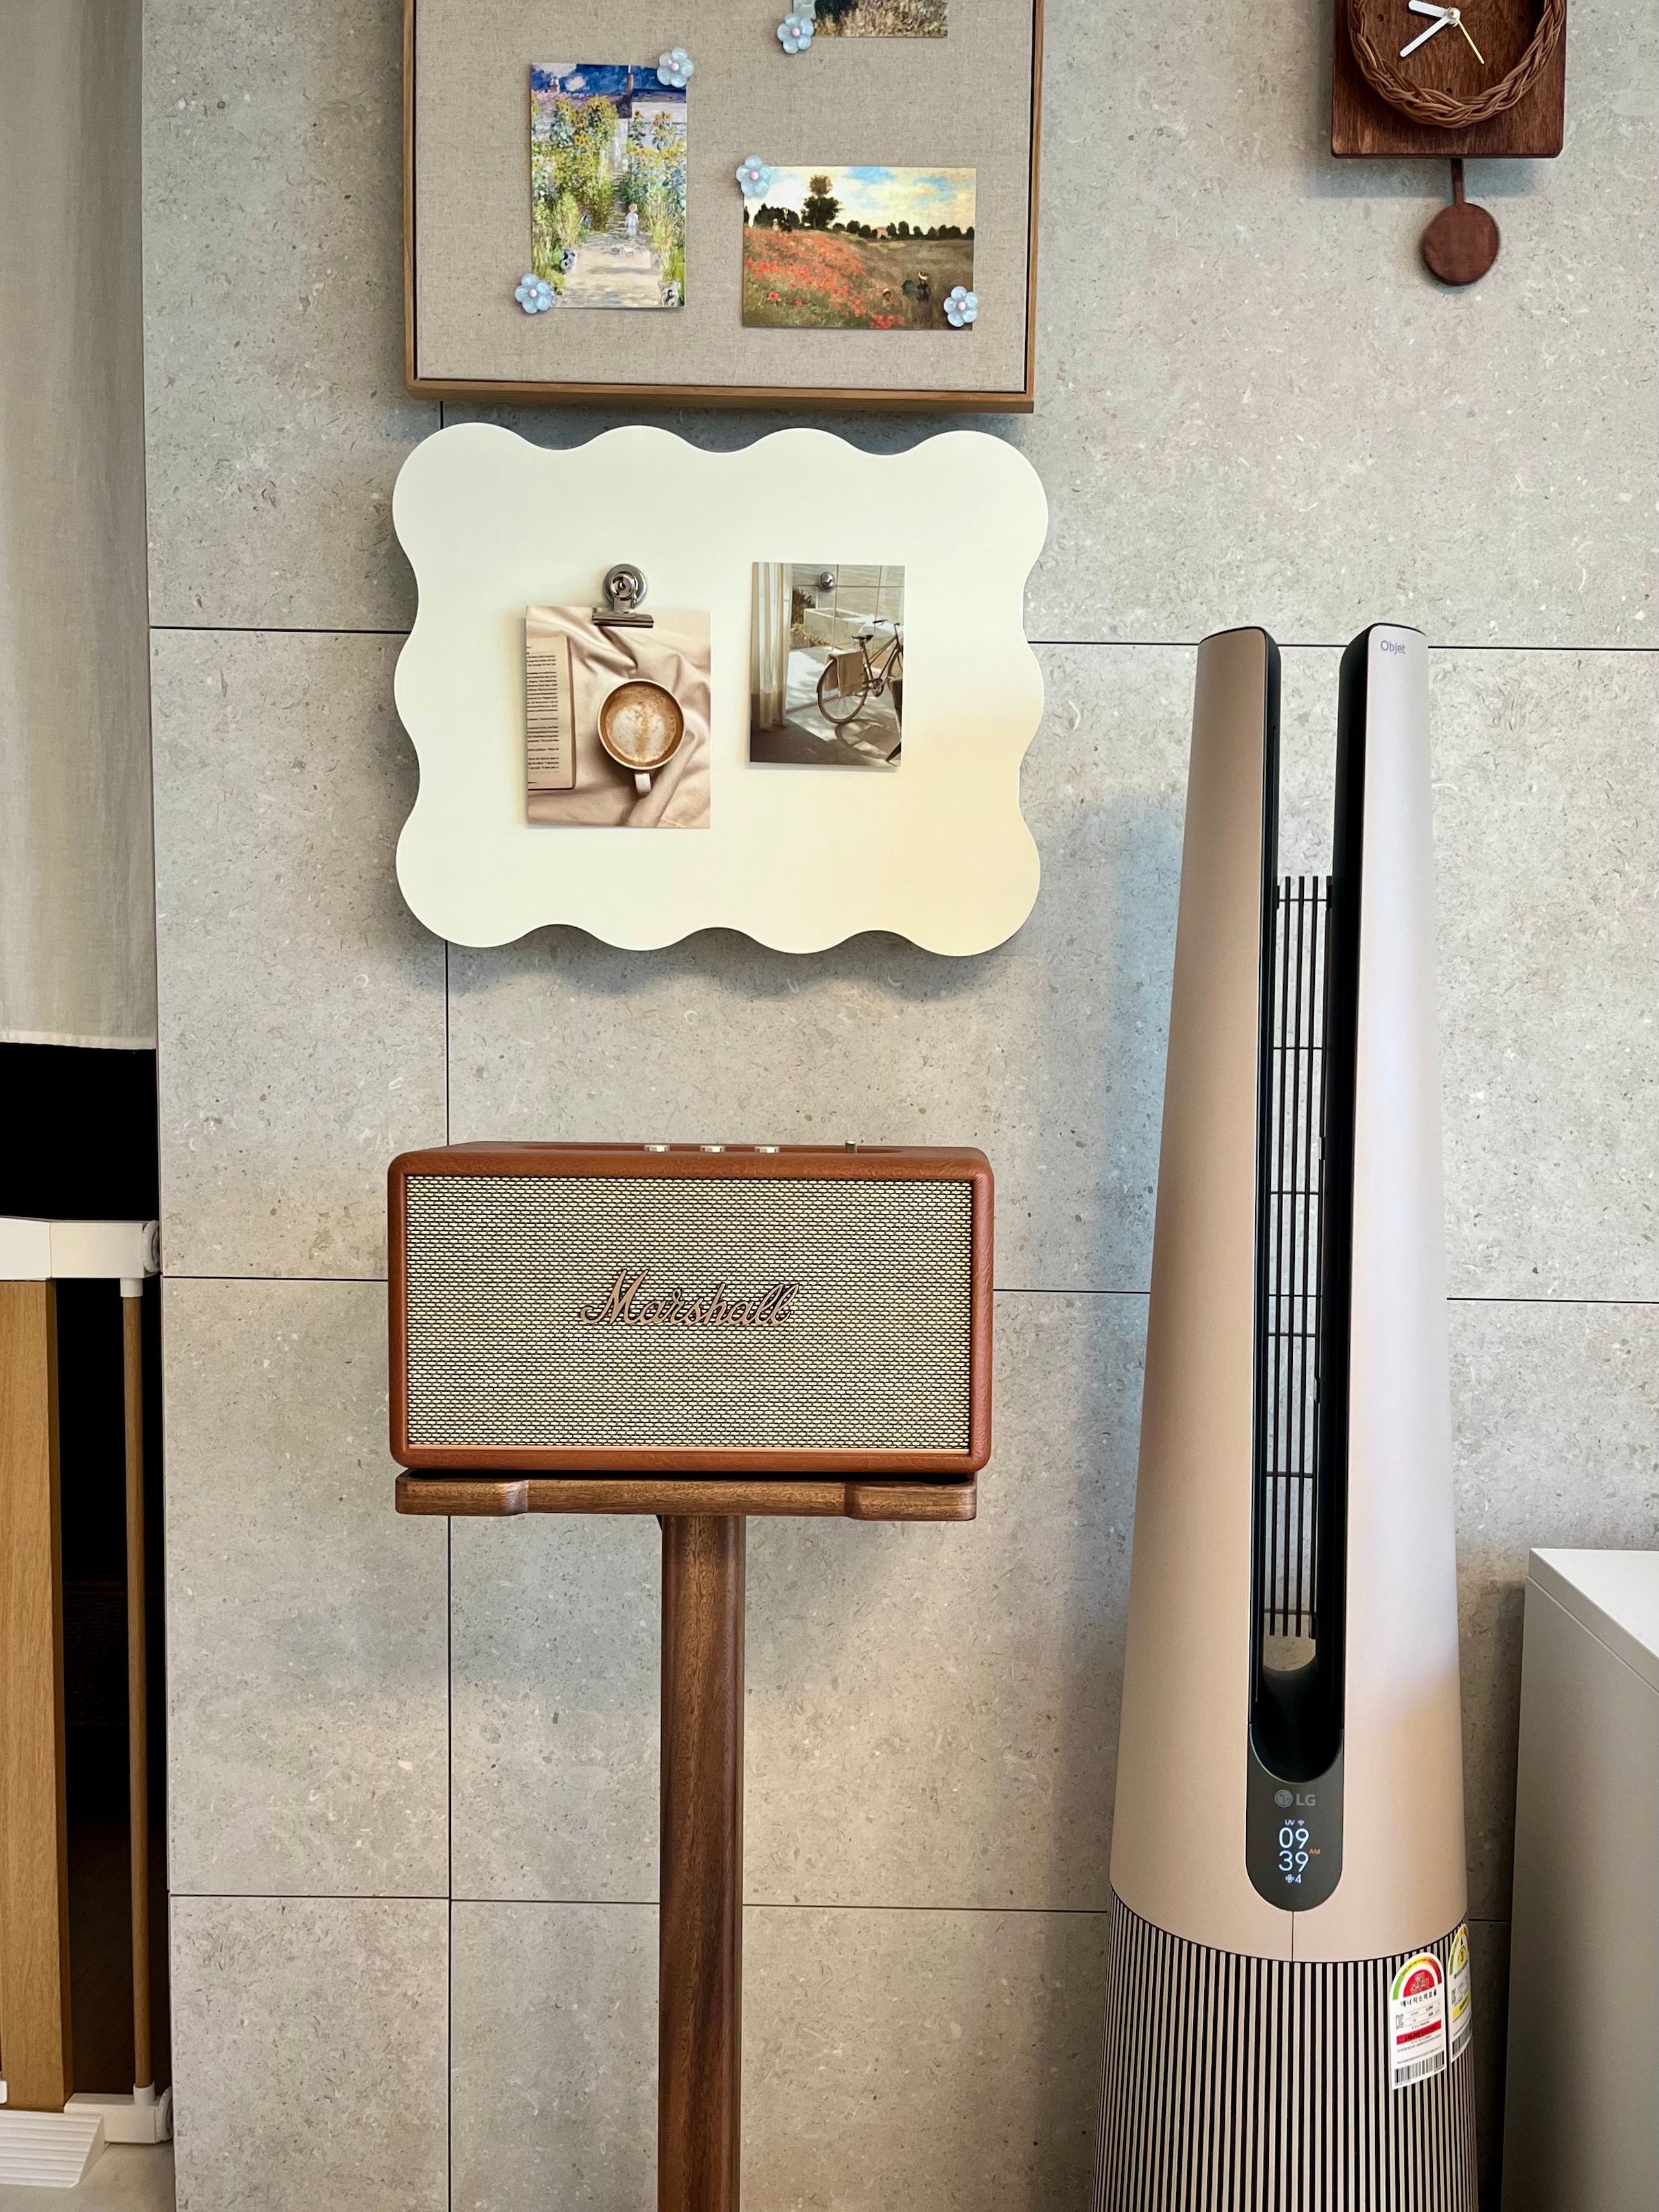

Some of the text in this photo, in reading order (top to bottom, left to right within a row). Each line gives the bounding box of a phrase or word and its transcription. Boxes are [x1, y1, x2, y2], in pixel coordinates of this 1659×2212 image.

[1380, 640, 1406, 655] Objet
[580, 1269, 800, 1326] Marshall
[1296, 1793, 1316, 1806] LG
[1279, 1826, 1310, 1850] 09
[1278, 1850, 1309, 1872] 39
